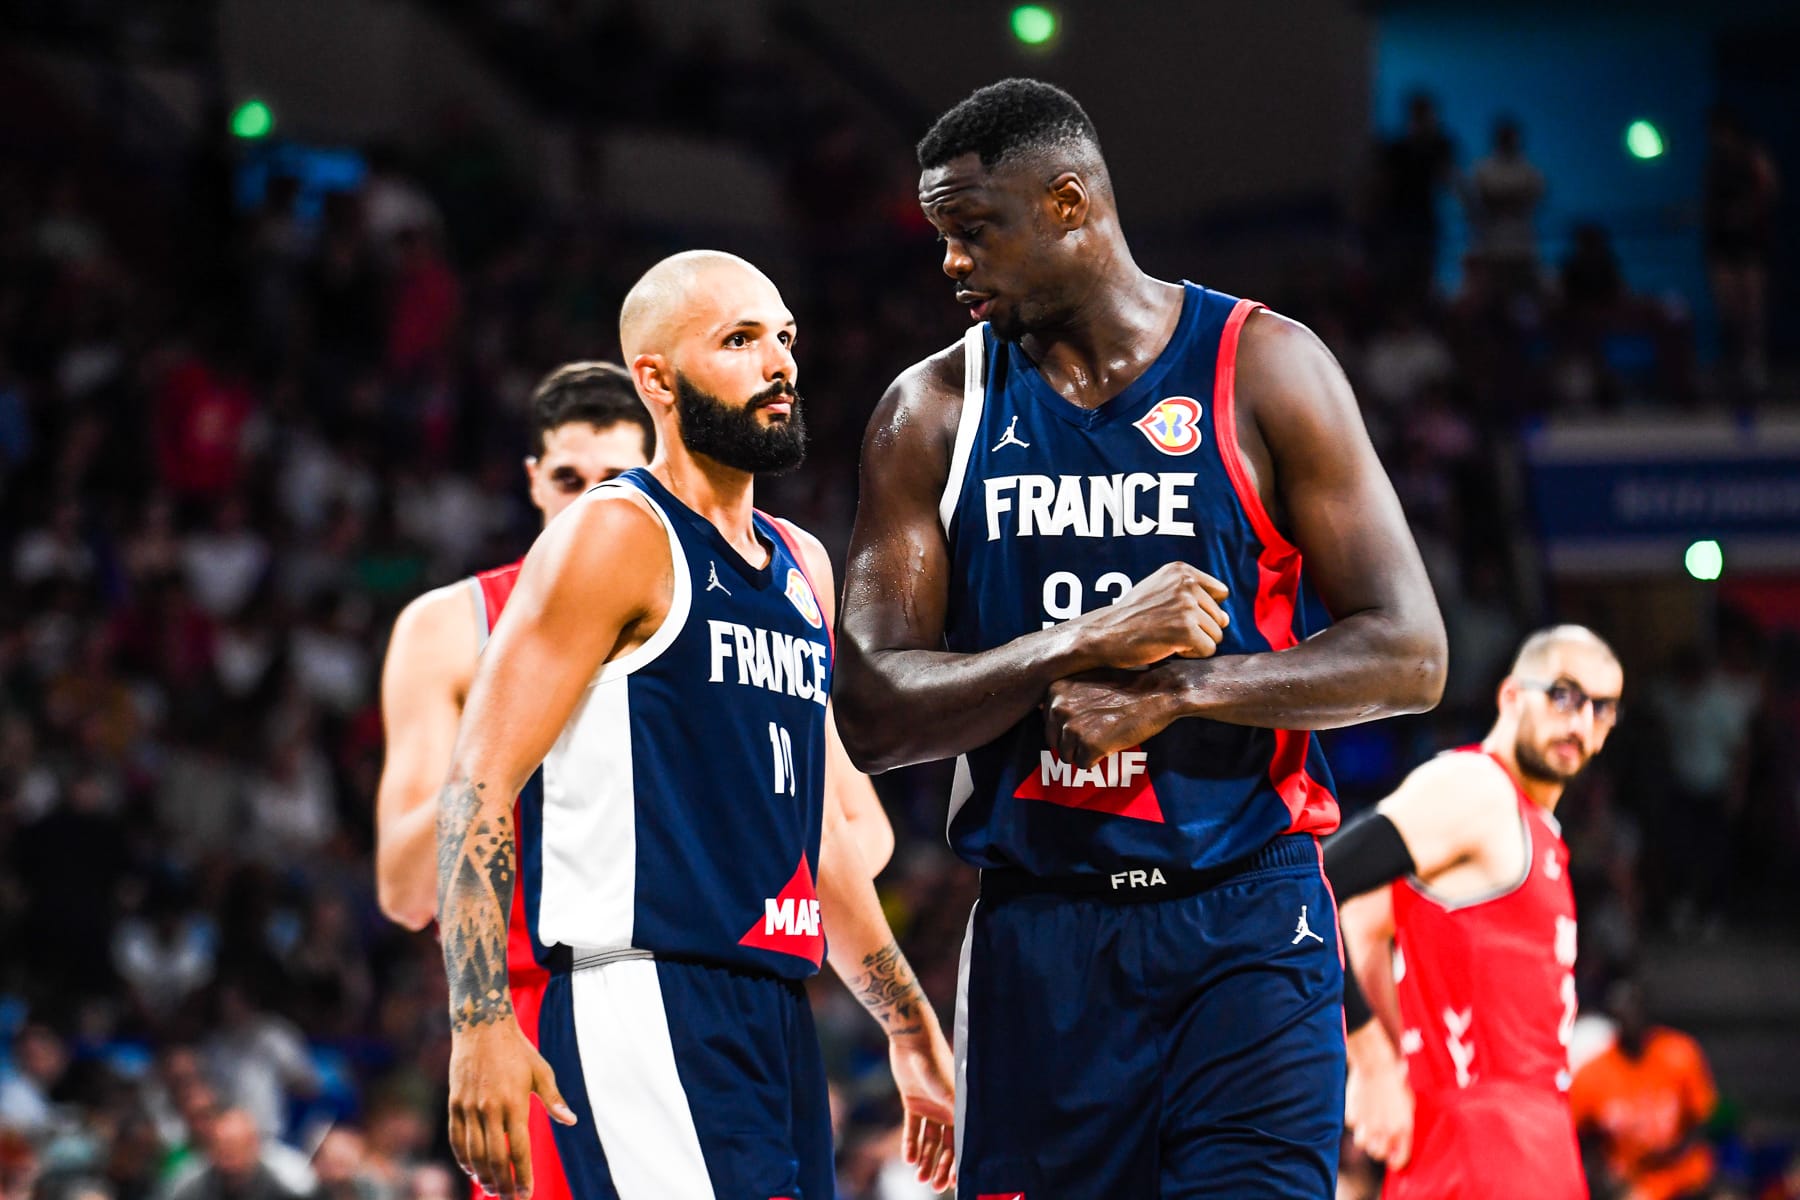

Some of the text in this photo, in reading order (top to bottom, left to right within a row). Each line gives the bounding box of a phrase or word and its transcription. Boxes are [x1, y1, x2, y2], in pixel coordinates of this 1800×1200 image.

[983, 472, 1198, 542] FRANCE
[707, 619, 827, 707] FRANCE
[1040, 750, 1148, 788] MAIF
[1111, 868, 1167, 890] FRA
